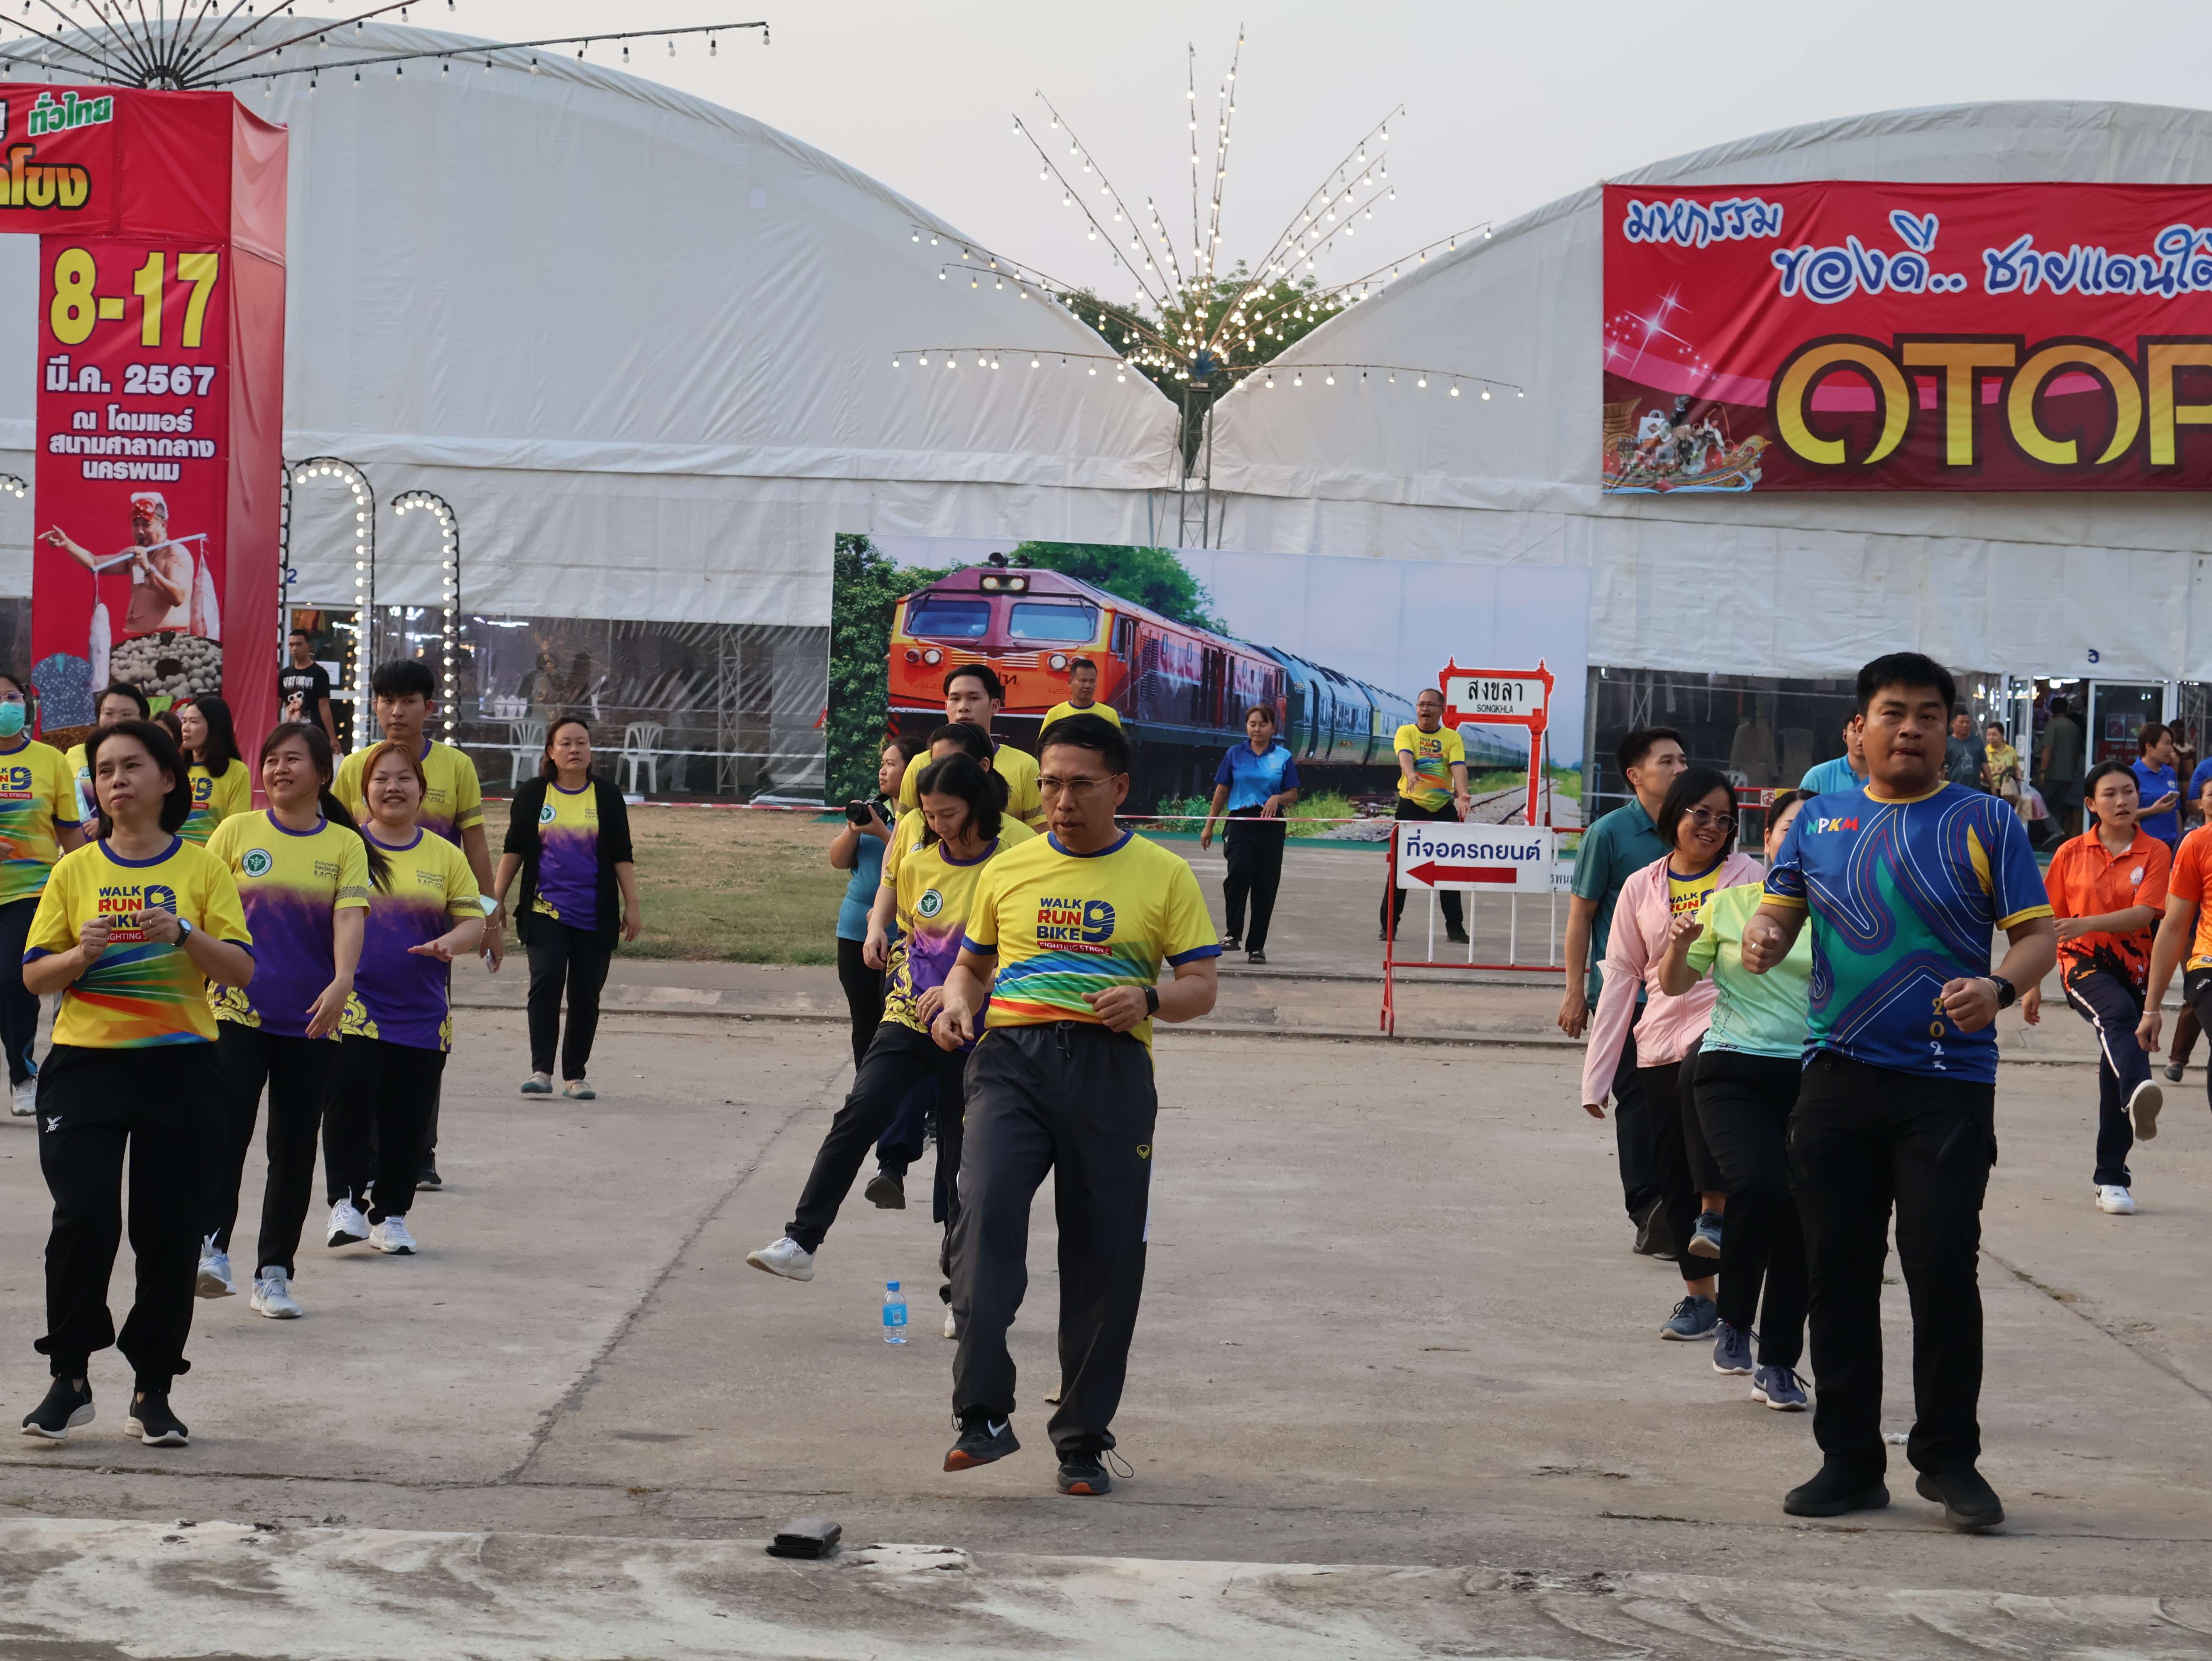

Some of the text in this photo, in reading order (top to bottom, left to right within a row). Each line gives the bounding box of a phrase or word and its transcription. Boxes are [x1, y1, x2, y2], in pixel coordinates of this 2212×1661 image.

[29, 93, 111, 135] ทั่วไทย
[1627, 203, 1779, 244] มหกรรม
[50, 248, 219, 348] 8-17
[46, 355, 215, 395] มี.ค. 2567
[73, 404, 193, 433] ณ โดมแอร์
[49, 434, 215, 458] สนามศาลากลาง
[83, 461, 180, 481] นครพนม
[287, 568, 297, 584] 2
[1468, 679, 1523, 702] สงขลา
[1476, 704, 1514, 713] SONGKHLA
[10, 767, 32, 791] 9
[1806, 816, 1859, 835] NPKM
[1406, 829, 1542, 861] ที่จอดรถยนต์
[98, 885, 142, 897] WALK
[98, 898, 142, 912] RUN
[1040, 898, 1082, 909] WALK
[1037, 909, 1082, 926] RUN
[1082, 900, 1116, 943] 9
[1037, 926, 1080, 941] BIKE
[1079, 945, 1109, 955] STROKE
